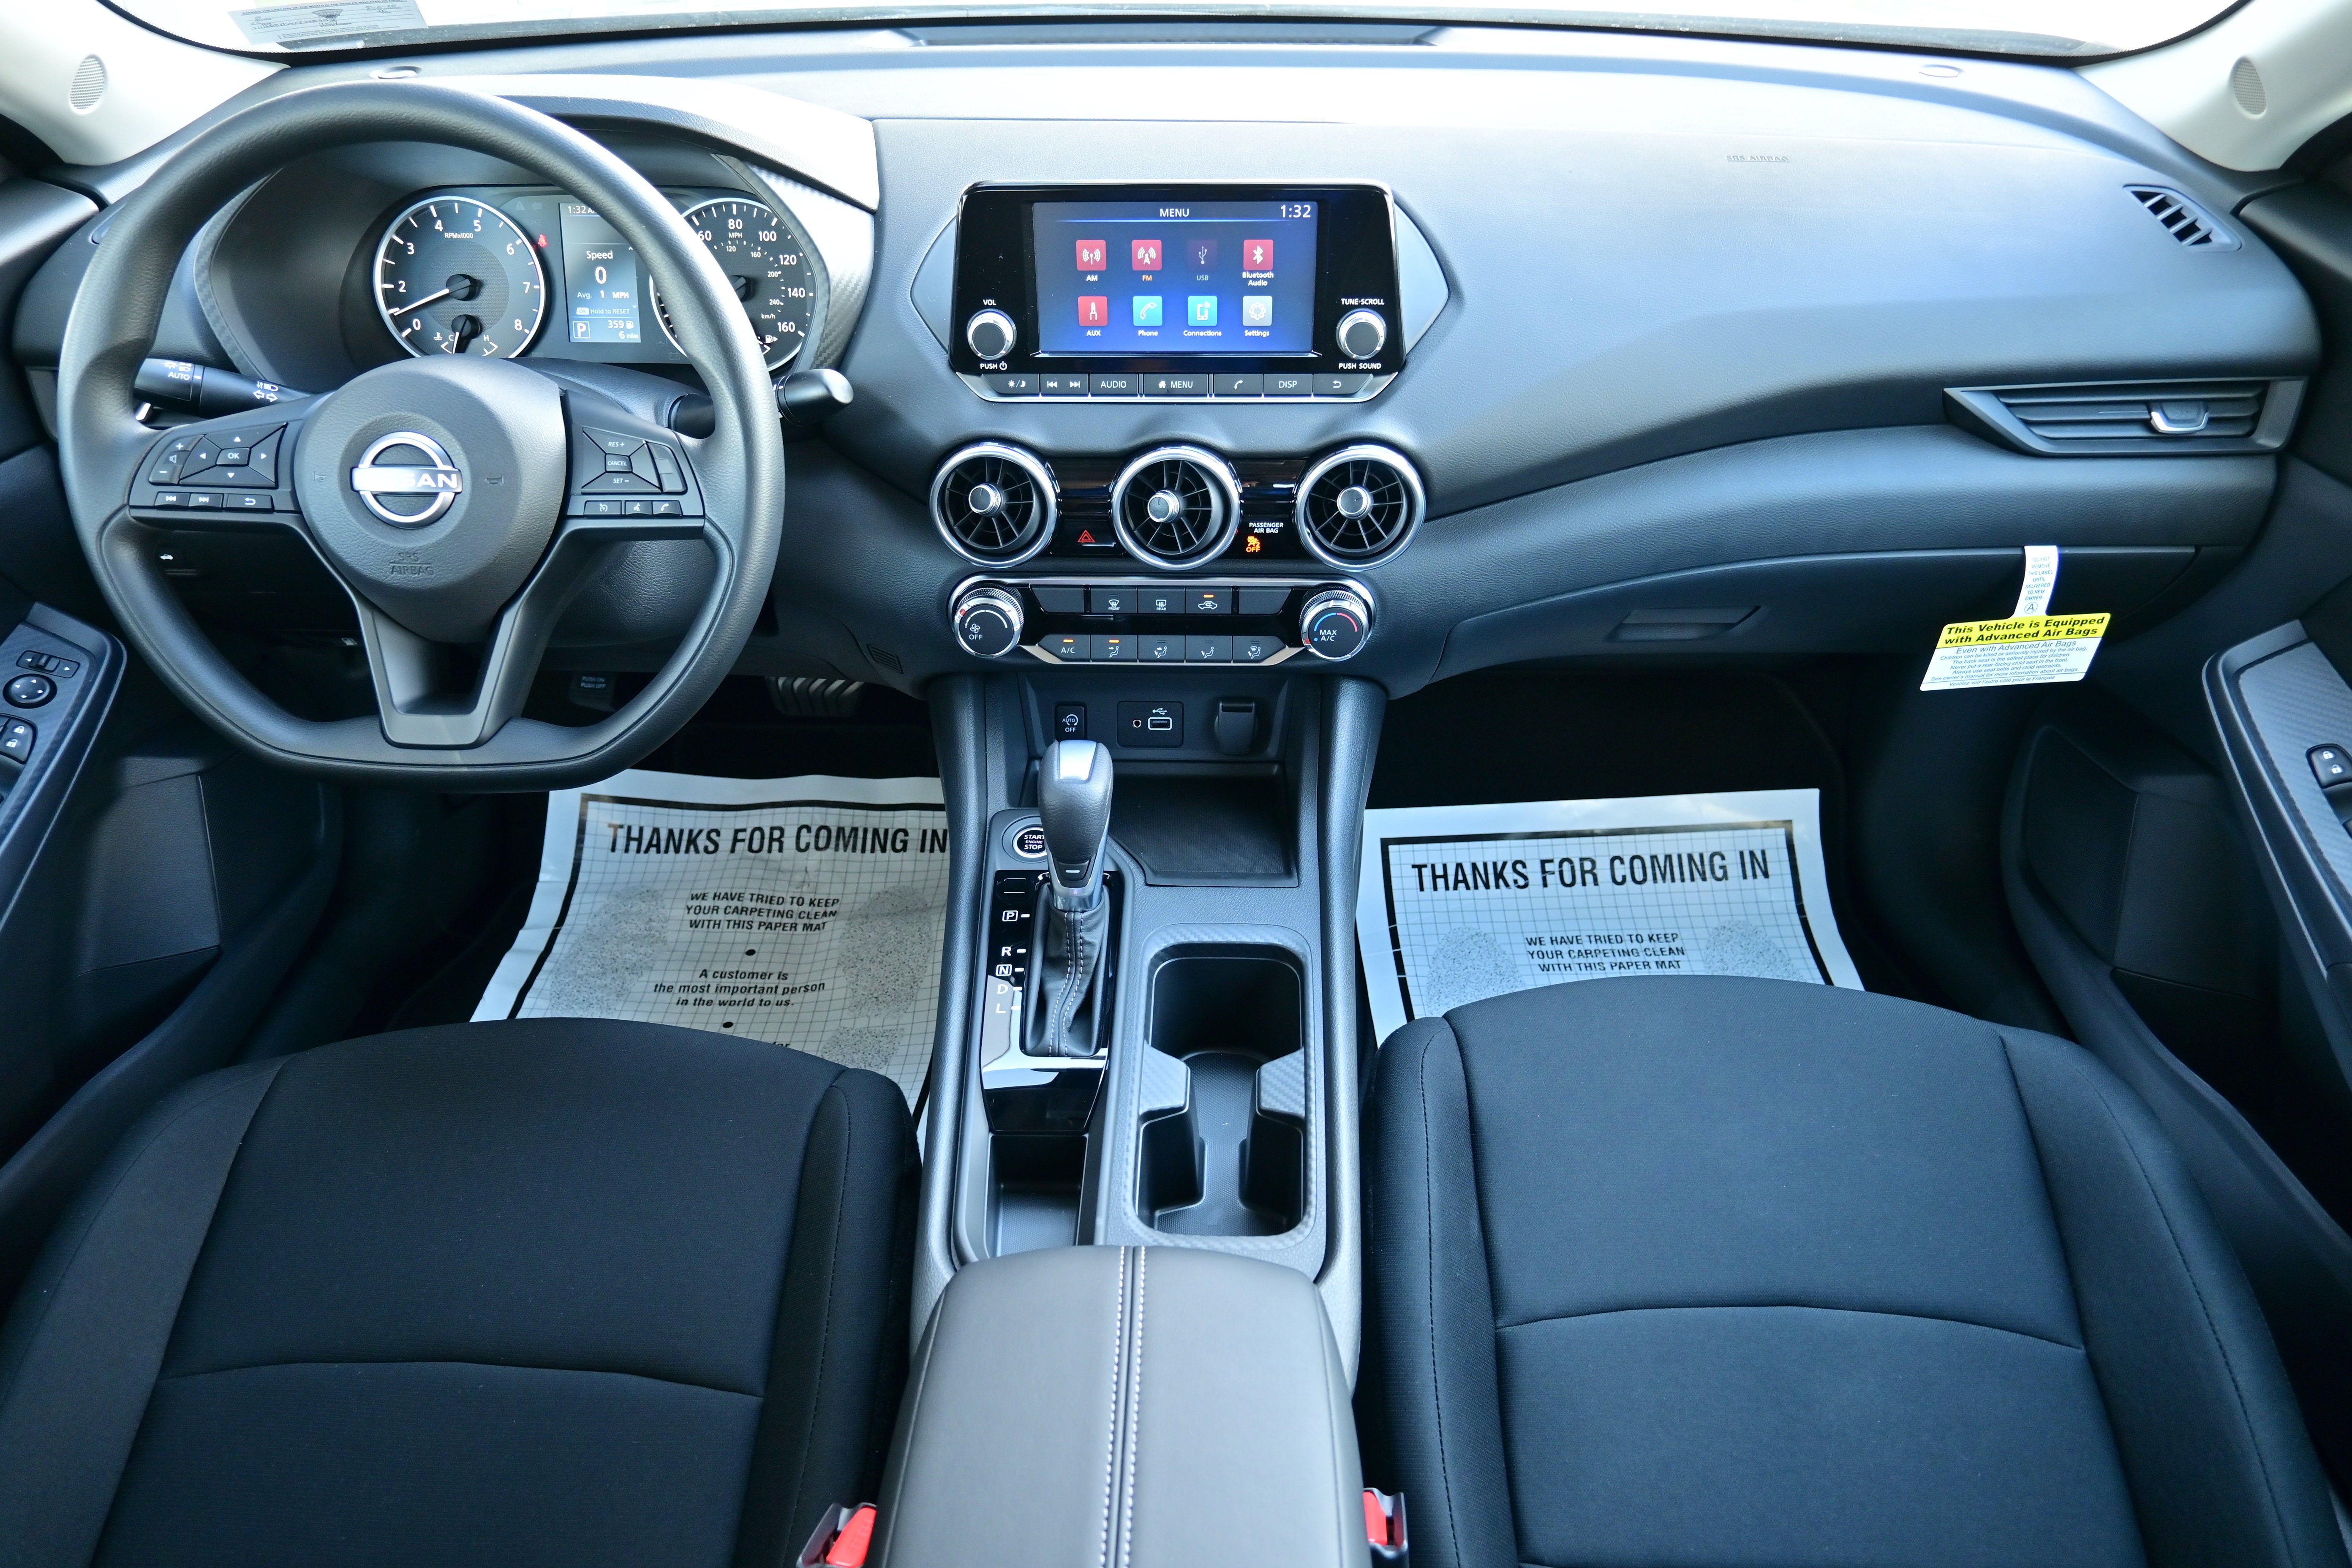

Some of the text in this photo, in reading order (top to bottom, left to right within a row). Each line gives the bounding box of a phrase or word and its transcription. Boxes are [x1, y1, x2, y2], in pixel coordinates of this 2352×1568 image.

[568, 206, 586, 214] 1:32
[1160, 208, 1190, 218] MENU
[1280, 205, 1311, 218] 1:32
[435, 220, 443, 231] 4
[474, 220, 482, 232] 5
[728, 219, 743, 230] 80
[697, 231, 712, 241] 60
[758, 231, 777, 242] 100
[407, 242, 415, 255] 3
[507, 243, 515, 255] 6
[586, 250, 613, 261] Speed
[779, 255, 797, 265] 120
[594, 267, 607, 285] 0
[398, 280, 406, 293] 2
[523, 282, 531, 293] 7
[577, 291, 592, 299] Avg.
[787, 288, 806, 298] 140
[413, 319, 421, 330] 0
[514, 319, 523, 331] 8
[607, 320, 624, 329] 359
[778, 322, 796, 332] 160
[577, 323, 587, 338] P
[619, 331, 625, 339] 6
[1244, 329, 1270, 338] Settings
[168, 371, 191, 381] AUTO
[1100, 381, 1127, 389] AUDIO
[1171, 381, 1193, 389] MENU
[398, 552, 420, 562] SRS
[391, 565, 434, 576] AIRBAG
[1947, 616, 2105, 634] This Vehicle is Equipped
[1945, 628, 2098, 645] with Advanced Air Bags
[1998, 642, 2040, 651] Advanced
[607, 823, 948, 855] THANKS FOR COMING IN
[1411, 849, 1769, 892] THANKS FOR COMING IN
[690, 892, 840, 908] WE HAVE TRIED TO KEEP
[686, 905, 837, 920] YOUR CARPETING CLEAN
[1006, 912, 1015, 920] P
[689, 919, 828, 932] WITH THIS PAPER MAT
[1526, 933, 1679, 947] WE HAVE TRIED TO KEEP
[1001, 946, 1012, 956] R
[1527, 947, 1685, 960] YOUR CARPETING CLEAN
[1000, 966, 1009, 975] N
[1538, 960, 1681, 972] WITH THIS PAPER MAT
[699, 969, 788, 980] A customer is
[653, 982, 825, 996] the most important person
[997, 984, 1009, 994] D
[676, 997, 689, 1006] in
[693, 997, 713, 1007] the
[718, 998, 754, 1007] world
[759, 998, 771, 1007] to
[996, 1004, 1006, 1014] L
